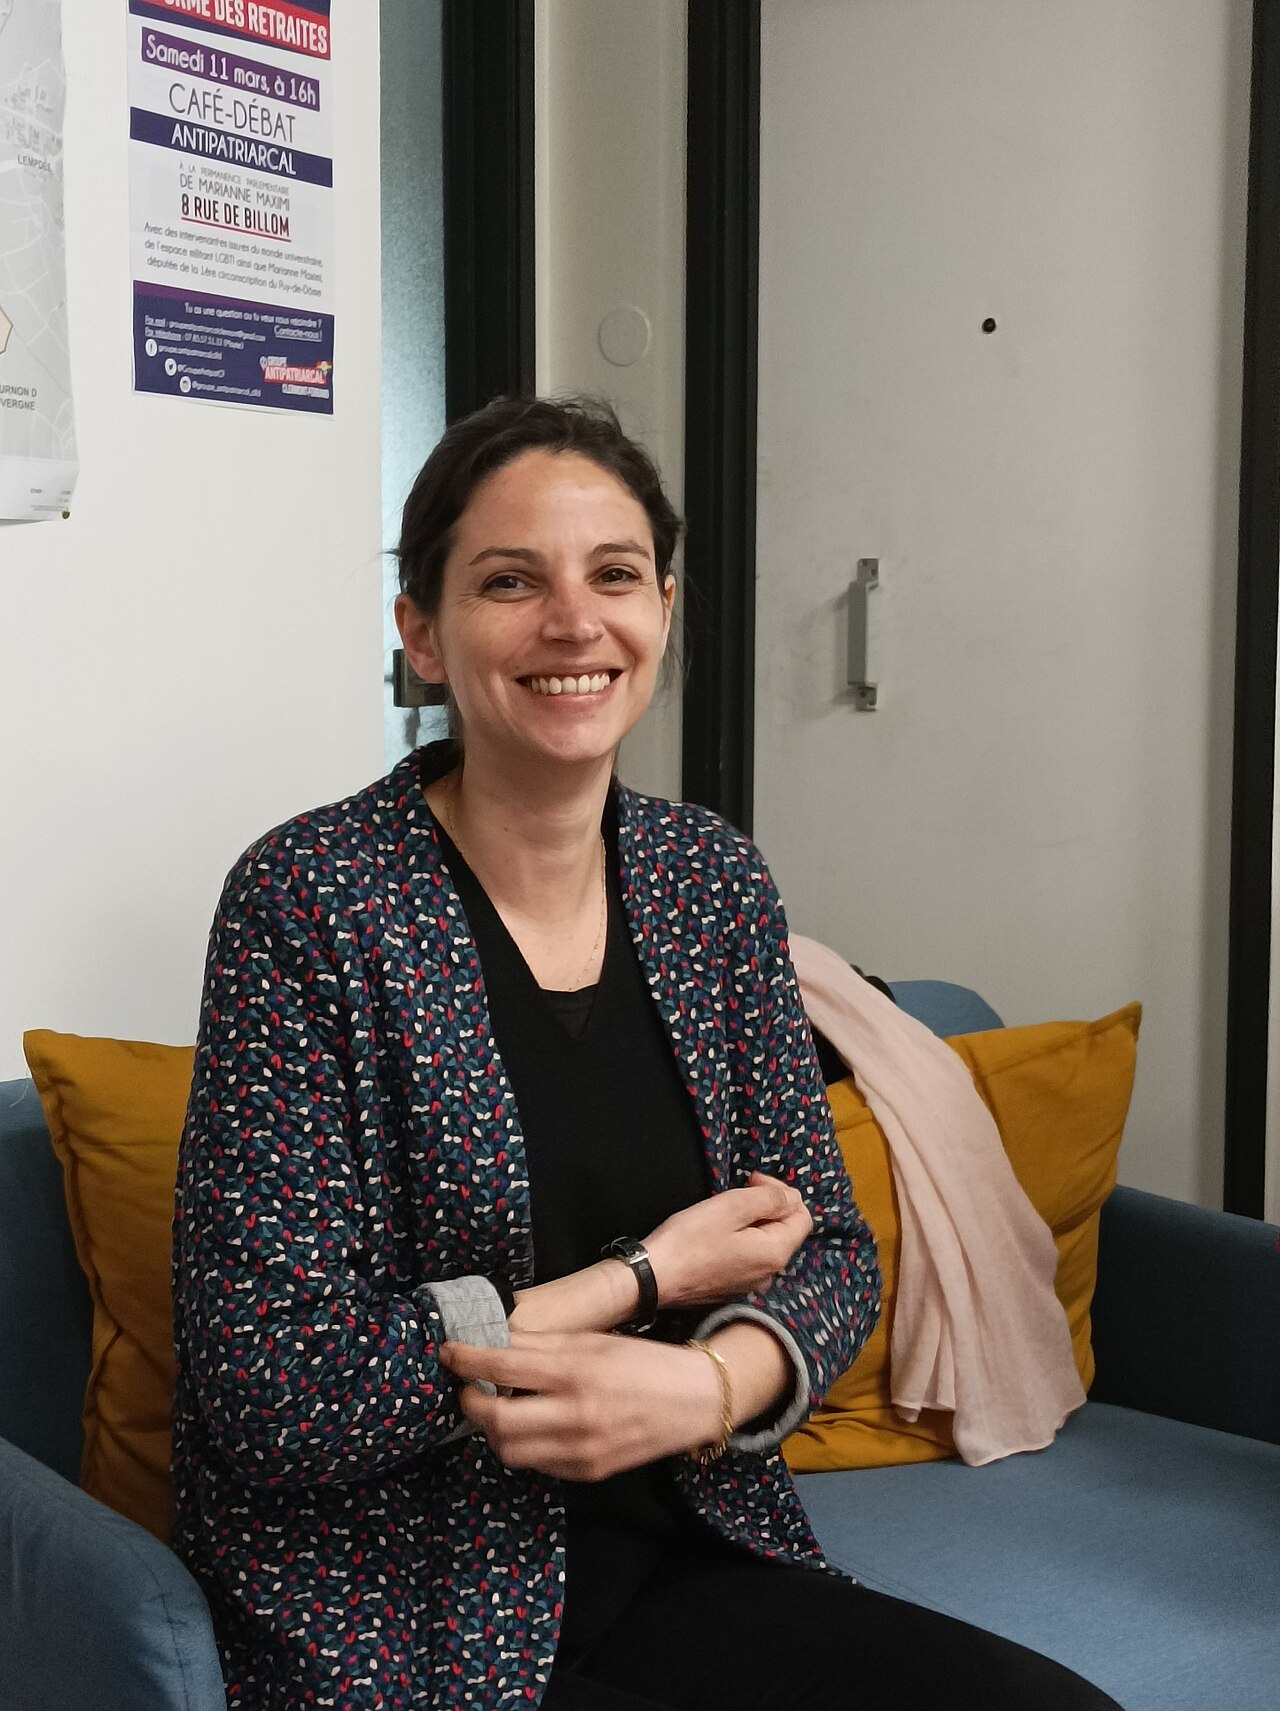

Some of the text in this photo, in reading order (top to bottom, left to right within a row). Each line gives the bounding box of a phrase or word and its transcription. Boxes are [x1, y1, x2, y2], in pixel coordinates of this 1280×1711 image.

[214, 0, 244, 28] DES
[248, 2, 328, 54] RETRAITES
[146, 33, 317, 106] Samedi 11 mars, à 16h
[168, 83, 296, 143] CAFÉ-DÉBAT
[171, 122, 297, 176] ANTIPATRIARCAL
[188, 165, 197, 174] LA
[179, 173, 290, 212] DE MARIANNE MAXIMI
[181, 193, 290, 238] 8 RUE DE BILLOM
[144, 221, 163, 236] Avec
[164, 226, 178, 239] des
[250, 244, 260, 255] du
[144, 239, 155, 250] de
[253, 262, 267, 272] que
[180, 262, 190, 273] de
[191, 263, 199, 275] la
[268, 278, 278, 290] du
